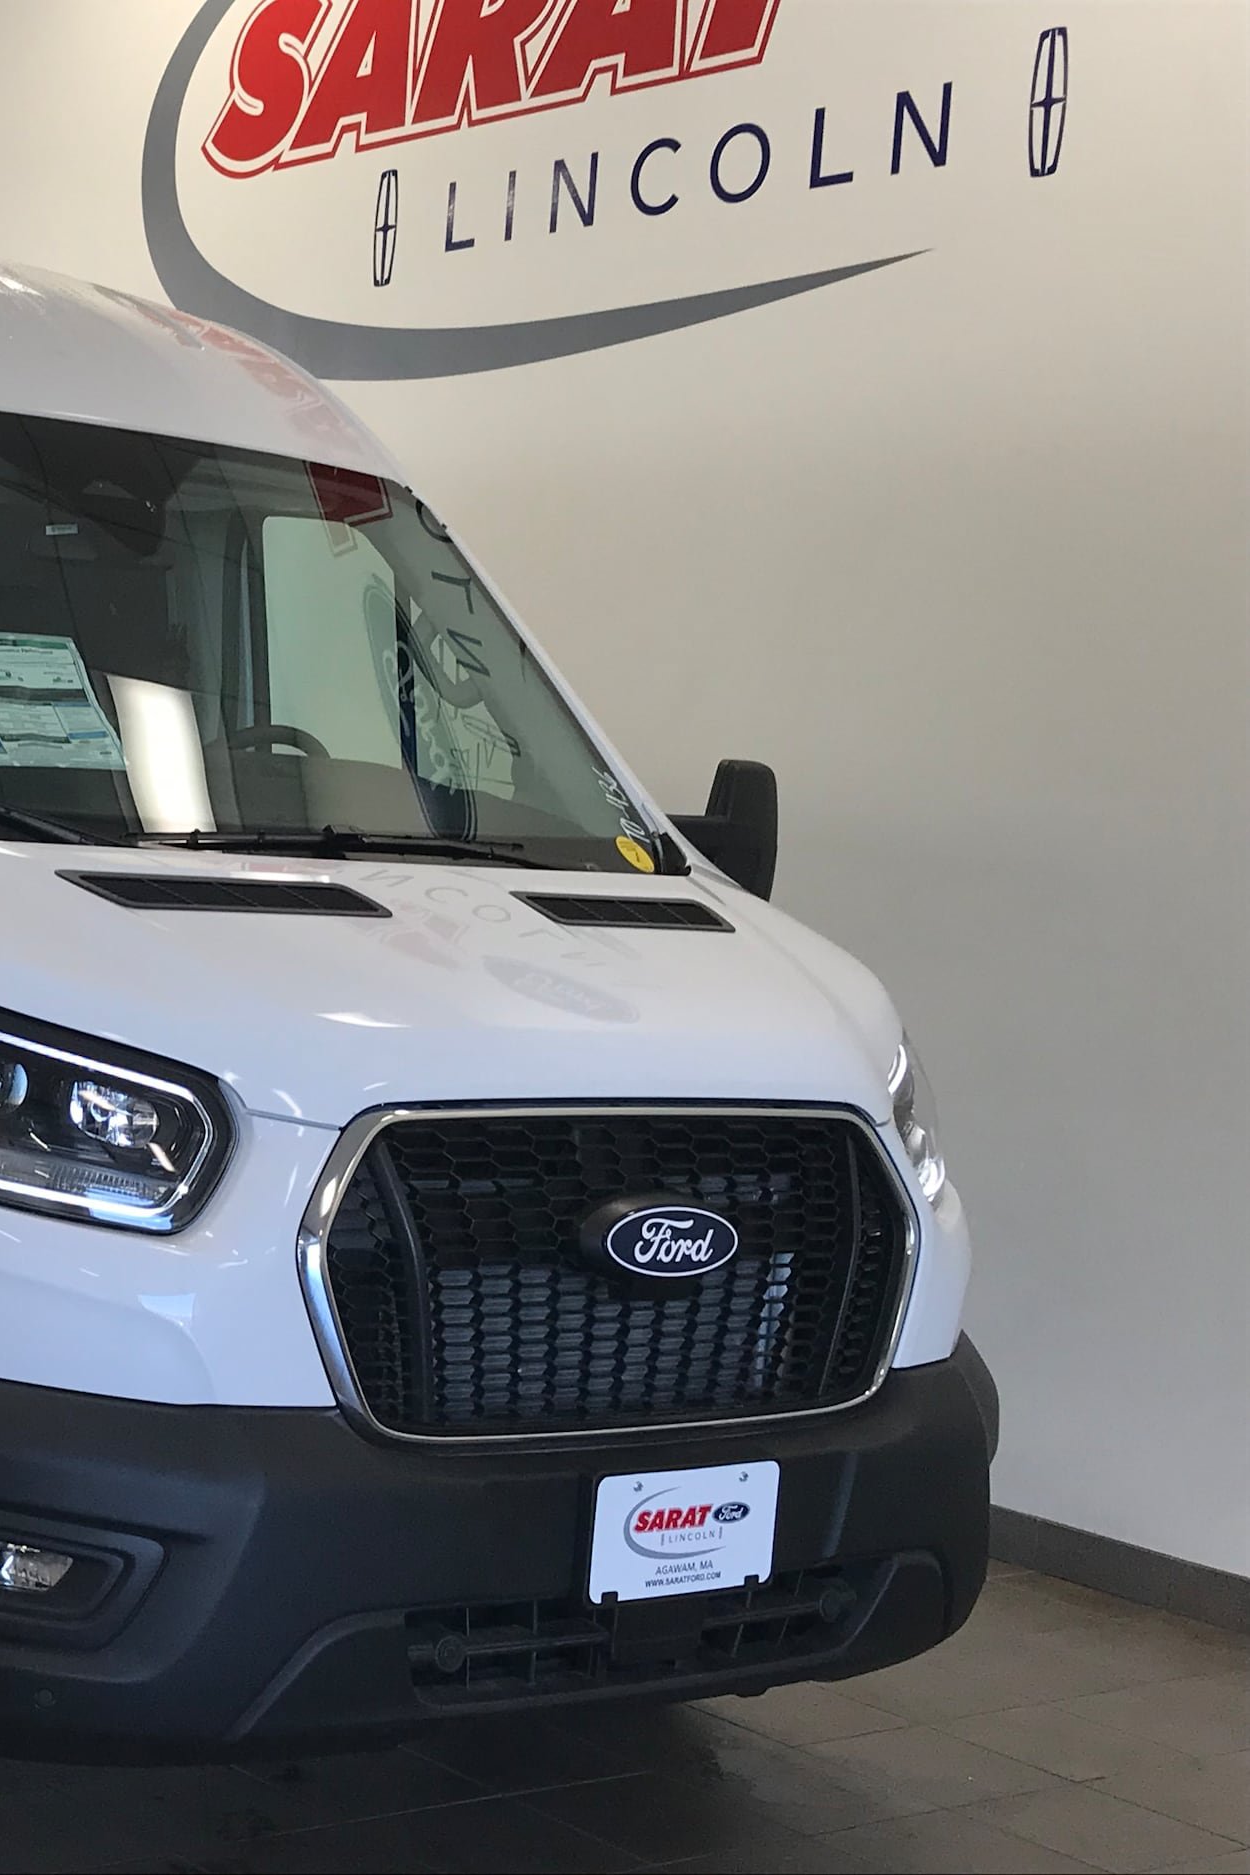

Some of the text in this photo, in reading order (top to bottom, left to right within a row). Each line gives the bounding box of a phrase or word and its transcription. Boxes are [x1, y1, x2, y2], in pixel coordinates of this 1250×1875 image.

[443, 80, 953, 254] LINCOLN
[634, 1217, 714, 1263] Ford
[634, 1504, 744, 1533] SARAT Ford
[668, 1530, 716, 1544] LINCOLN
[645, 1571, 722, 1588] WWW.SARATFORD.COM
[654, 1560, 714, 1576] AGAWAM, MA
